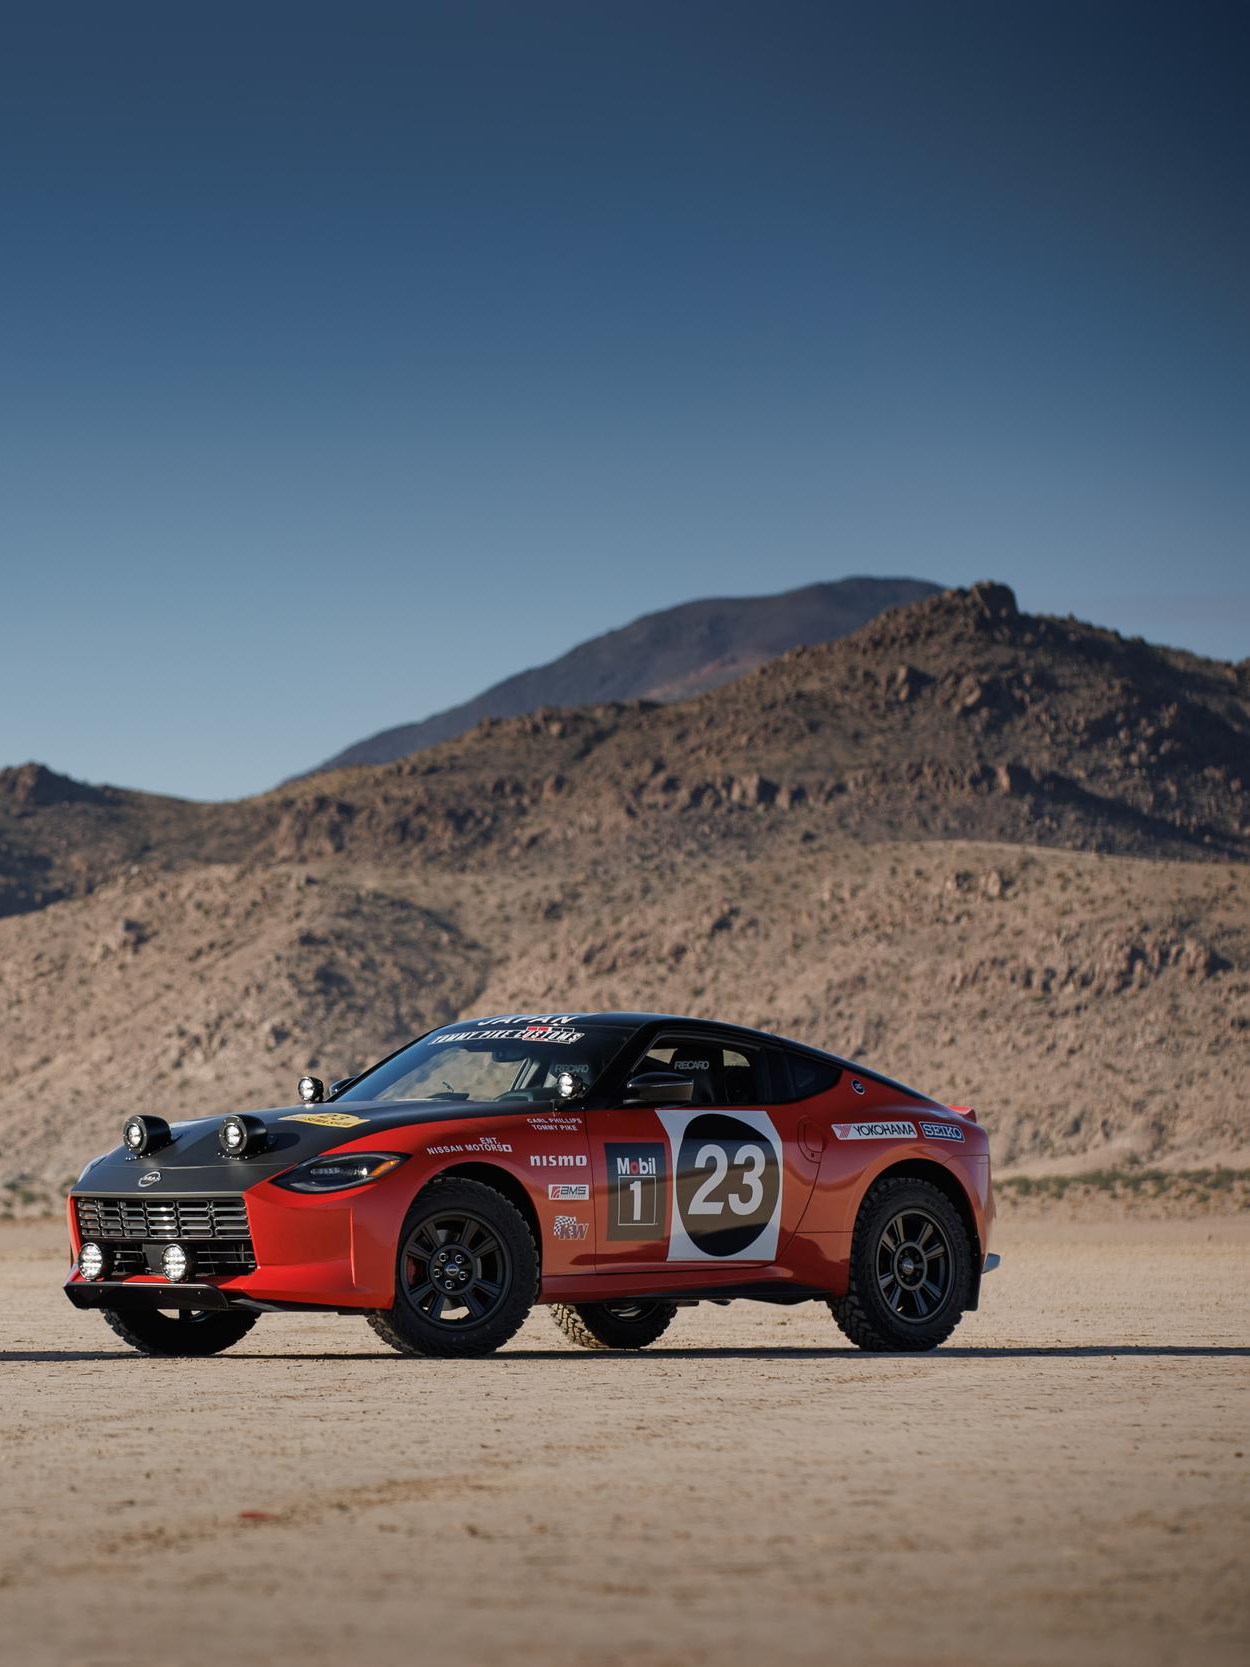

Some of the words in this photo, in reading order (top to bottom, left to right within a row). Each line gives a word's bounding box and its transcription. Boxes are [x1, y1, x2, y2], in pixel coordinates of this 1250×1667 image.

[554, 1064, 589, 1073] RECARO
[674, 1061, 709, 1070] RECARO
[852, 1124, 915, 1136] YOKOHAMA
[923, 1124, 962, 1139] SEIKO
[426, 1144, 464, 1155] NISSAN
[465, 1143, 503, 1152] MOTORS
[616, 1157, 656, 1175] Mobil
[687, 1144, 766, 1215] 23
[629, 1180, 642, 1221] 1
